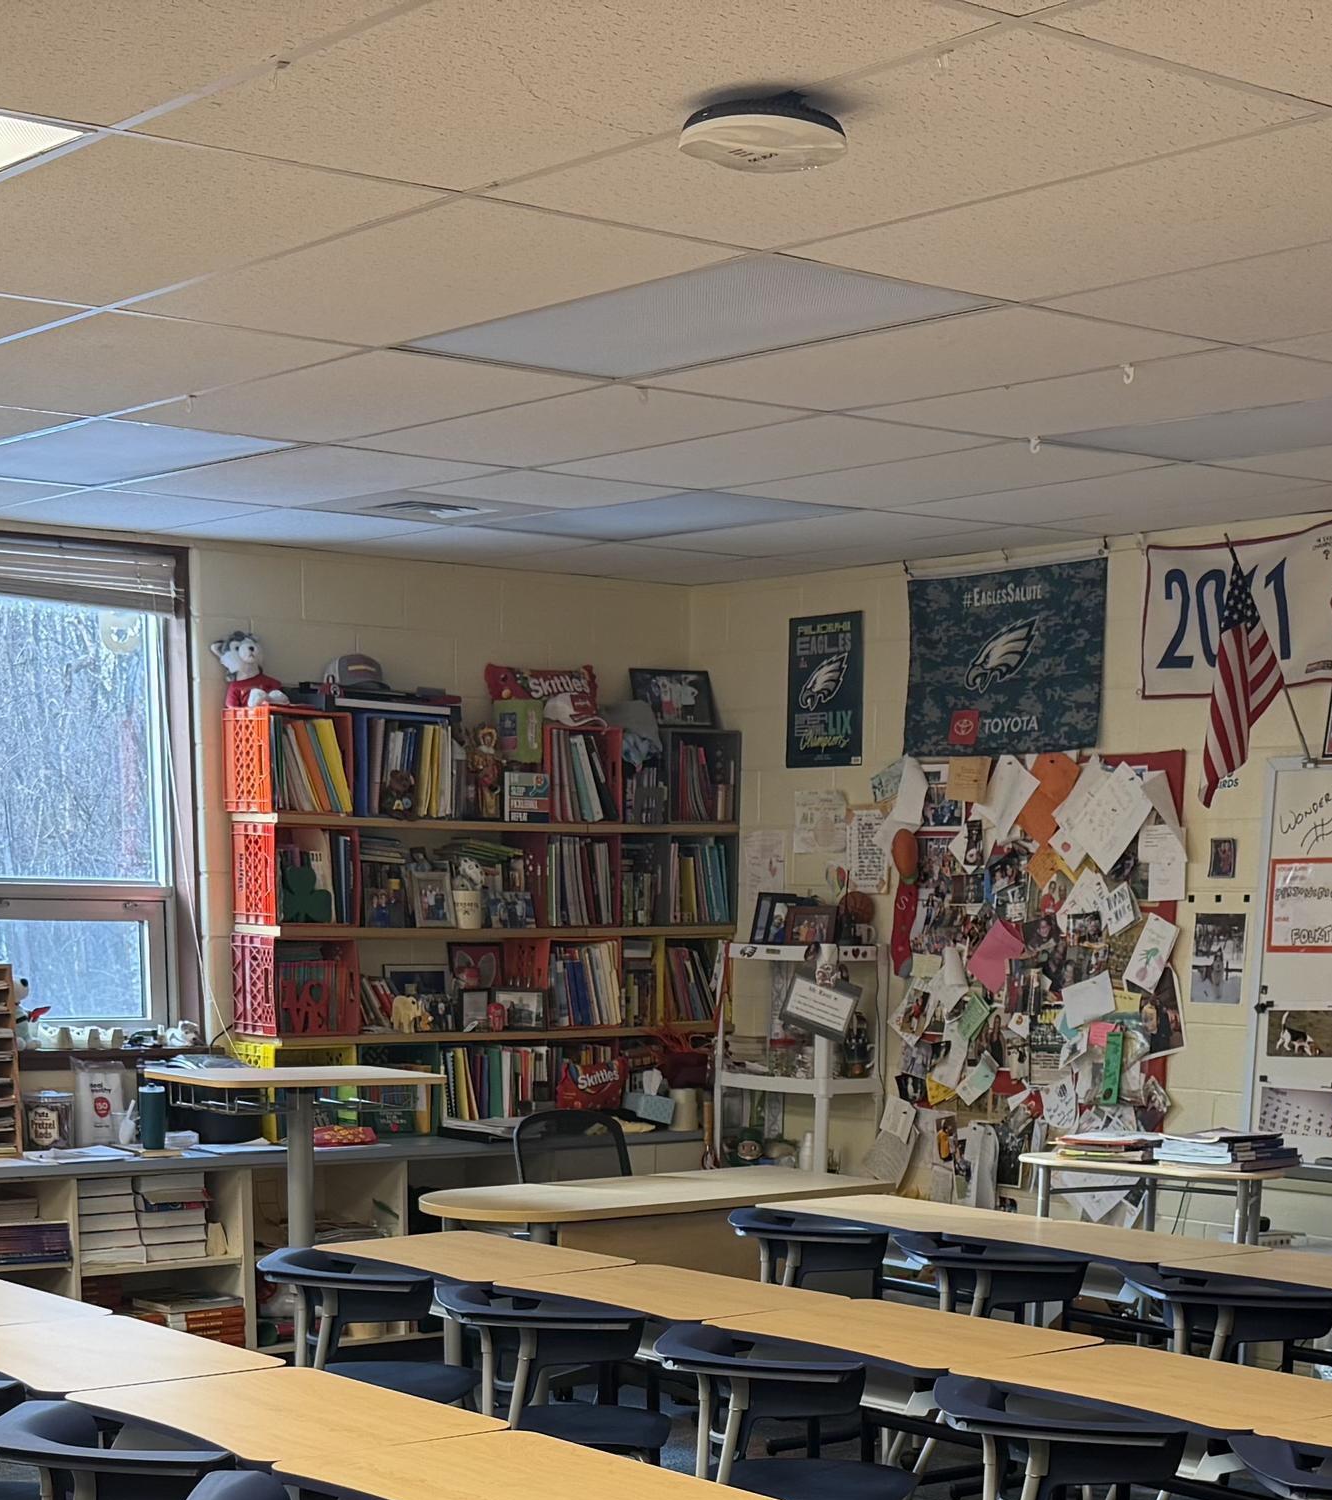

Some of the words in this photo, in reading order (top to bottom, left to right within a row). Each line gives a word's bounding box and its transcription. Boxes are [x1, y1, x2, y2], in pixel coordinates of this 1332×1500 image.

[1156, 556, 1292, 669] 201
[796, 632, 852, 656] EAGLES
[529, 674, 591, 700] Skittles
[827, 710, 853, 736] LIX
[983, 715, 1039, 734] TOYOTA
[577, 1068, 620, 1090] Skittles
[31, 1119, 56, 1130] Pretzel
